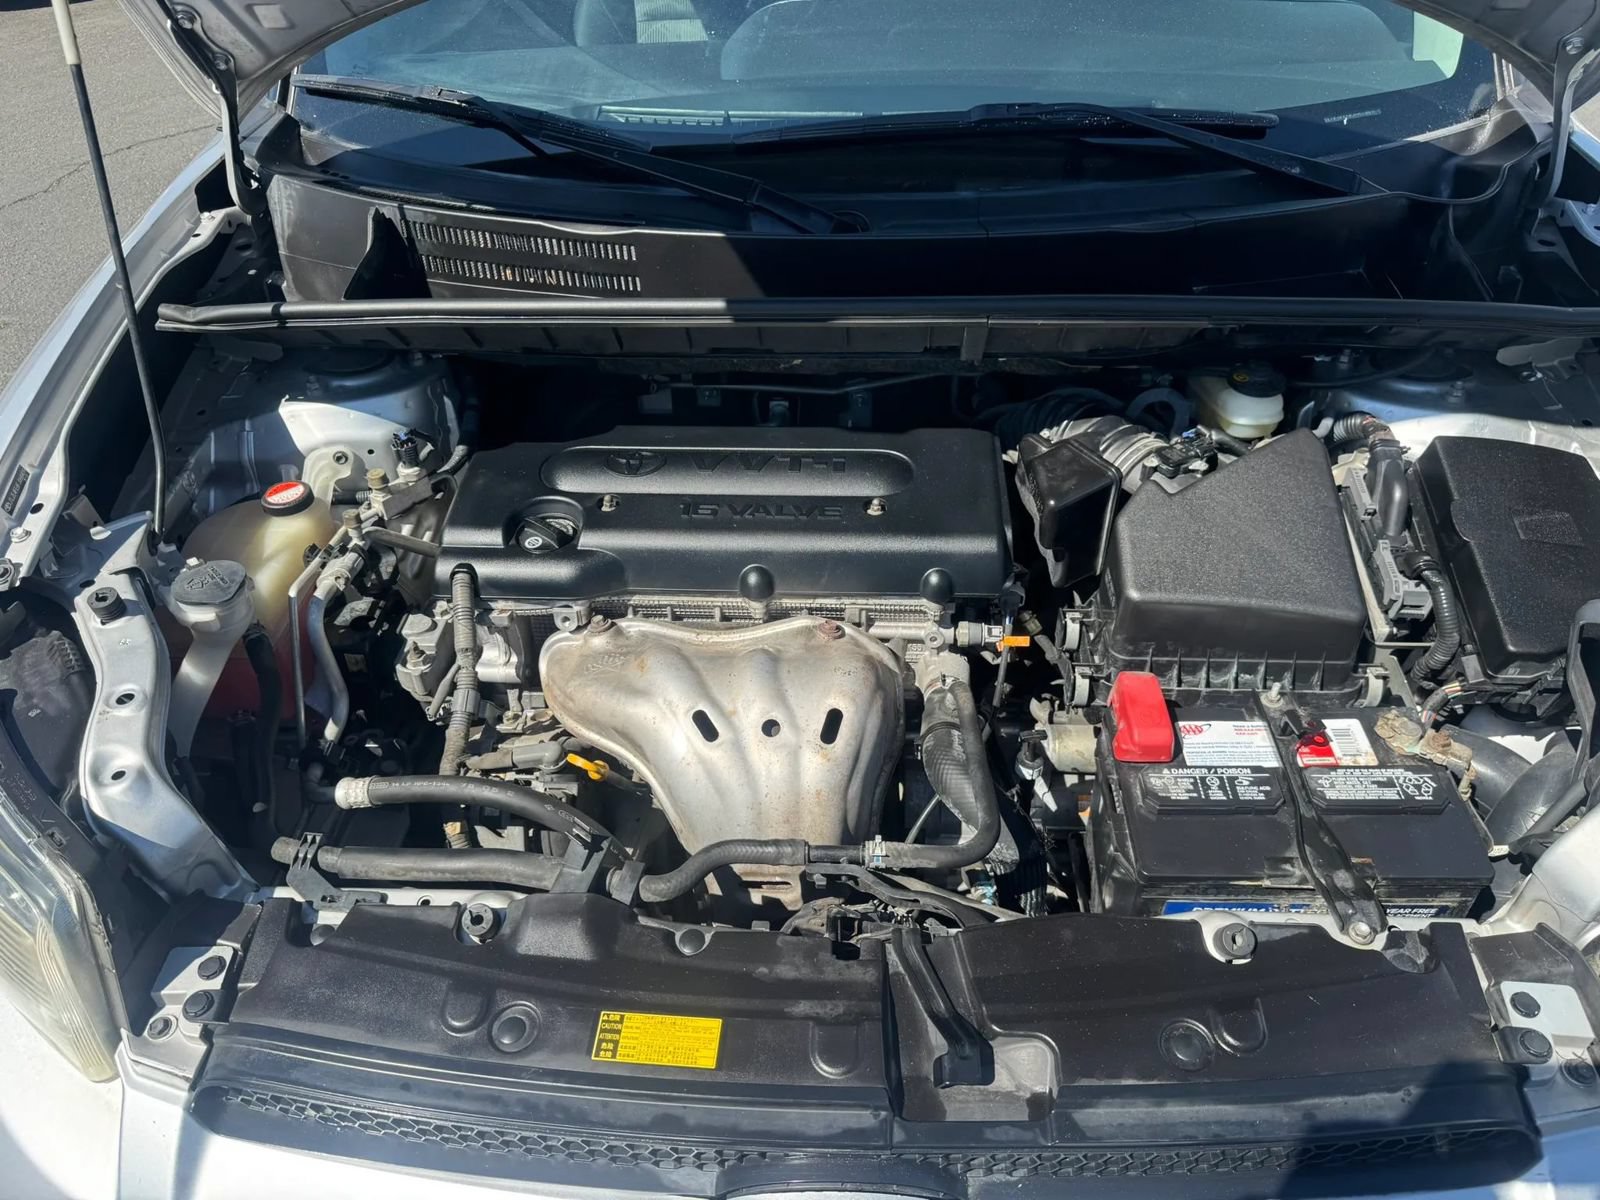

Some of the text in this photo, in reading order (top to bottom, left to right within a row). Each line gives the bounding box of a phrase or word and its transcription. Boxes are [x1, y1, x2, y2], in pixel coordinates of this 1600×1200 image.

[679, 503, 843, 520] 16 VALVE
[1180, 724, 1204, 735] AAA
[601, 1022, 622, 1030] CAUTION
